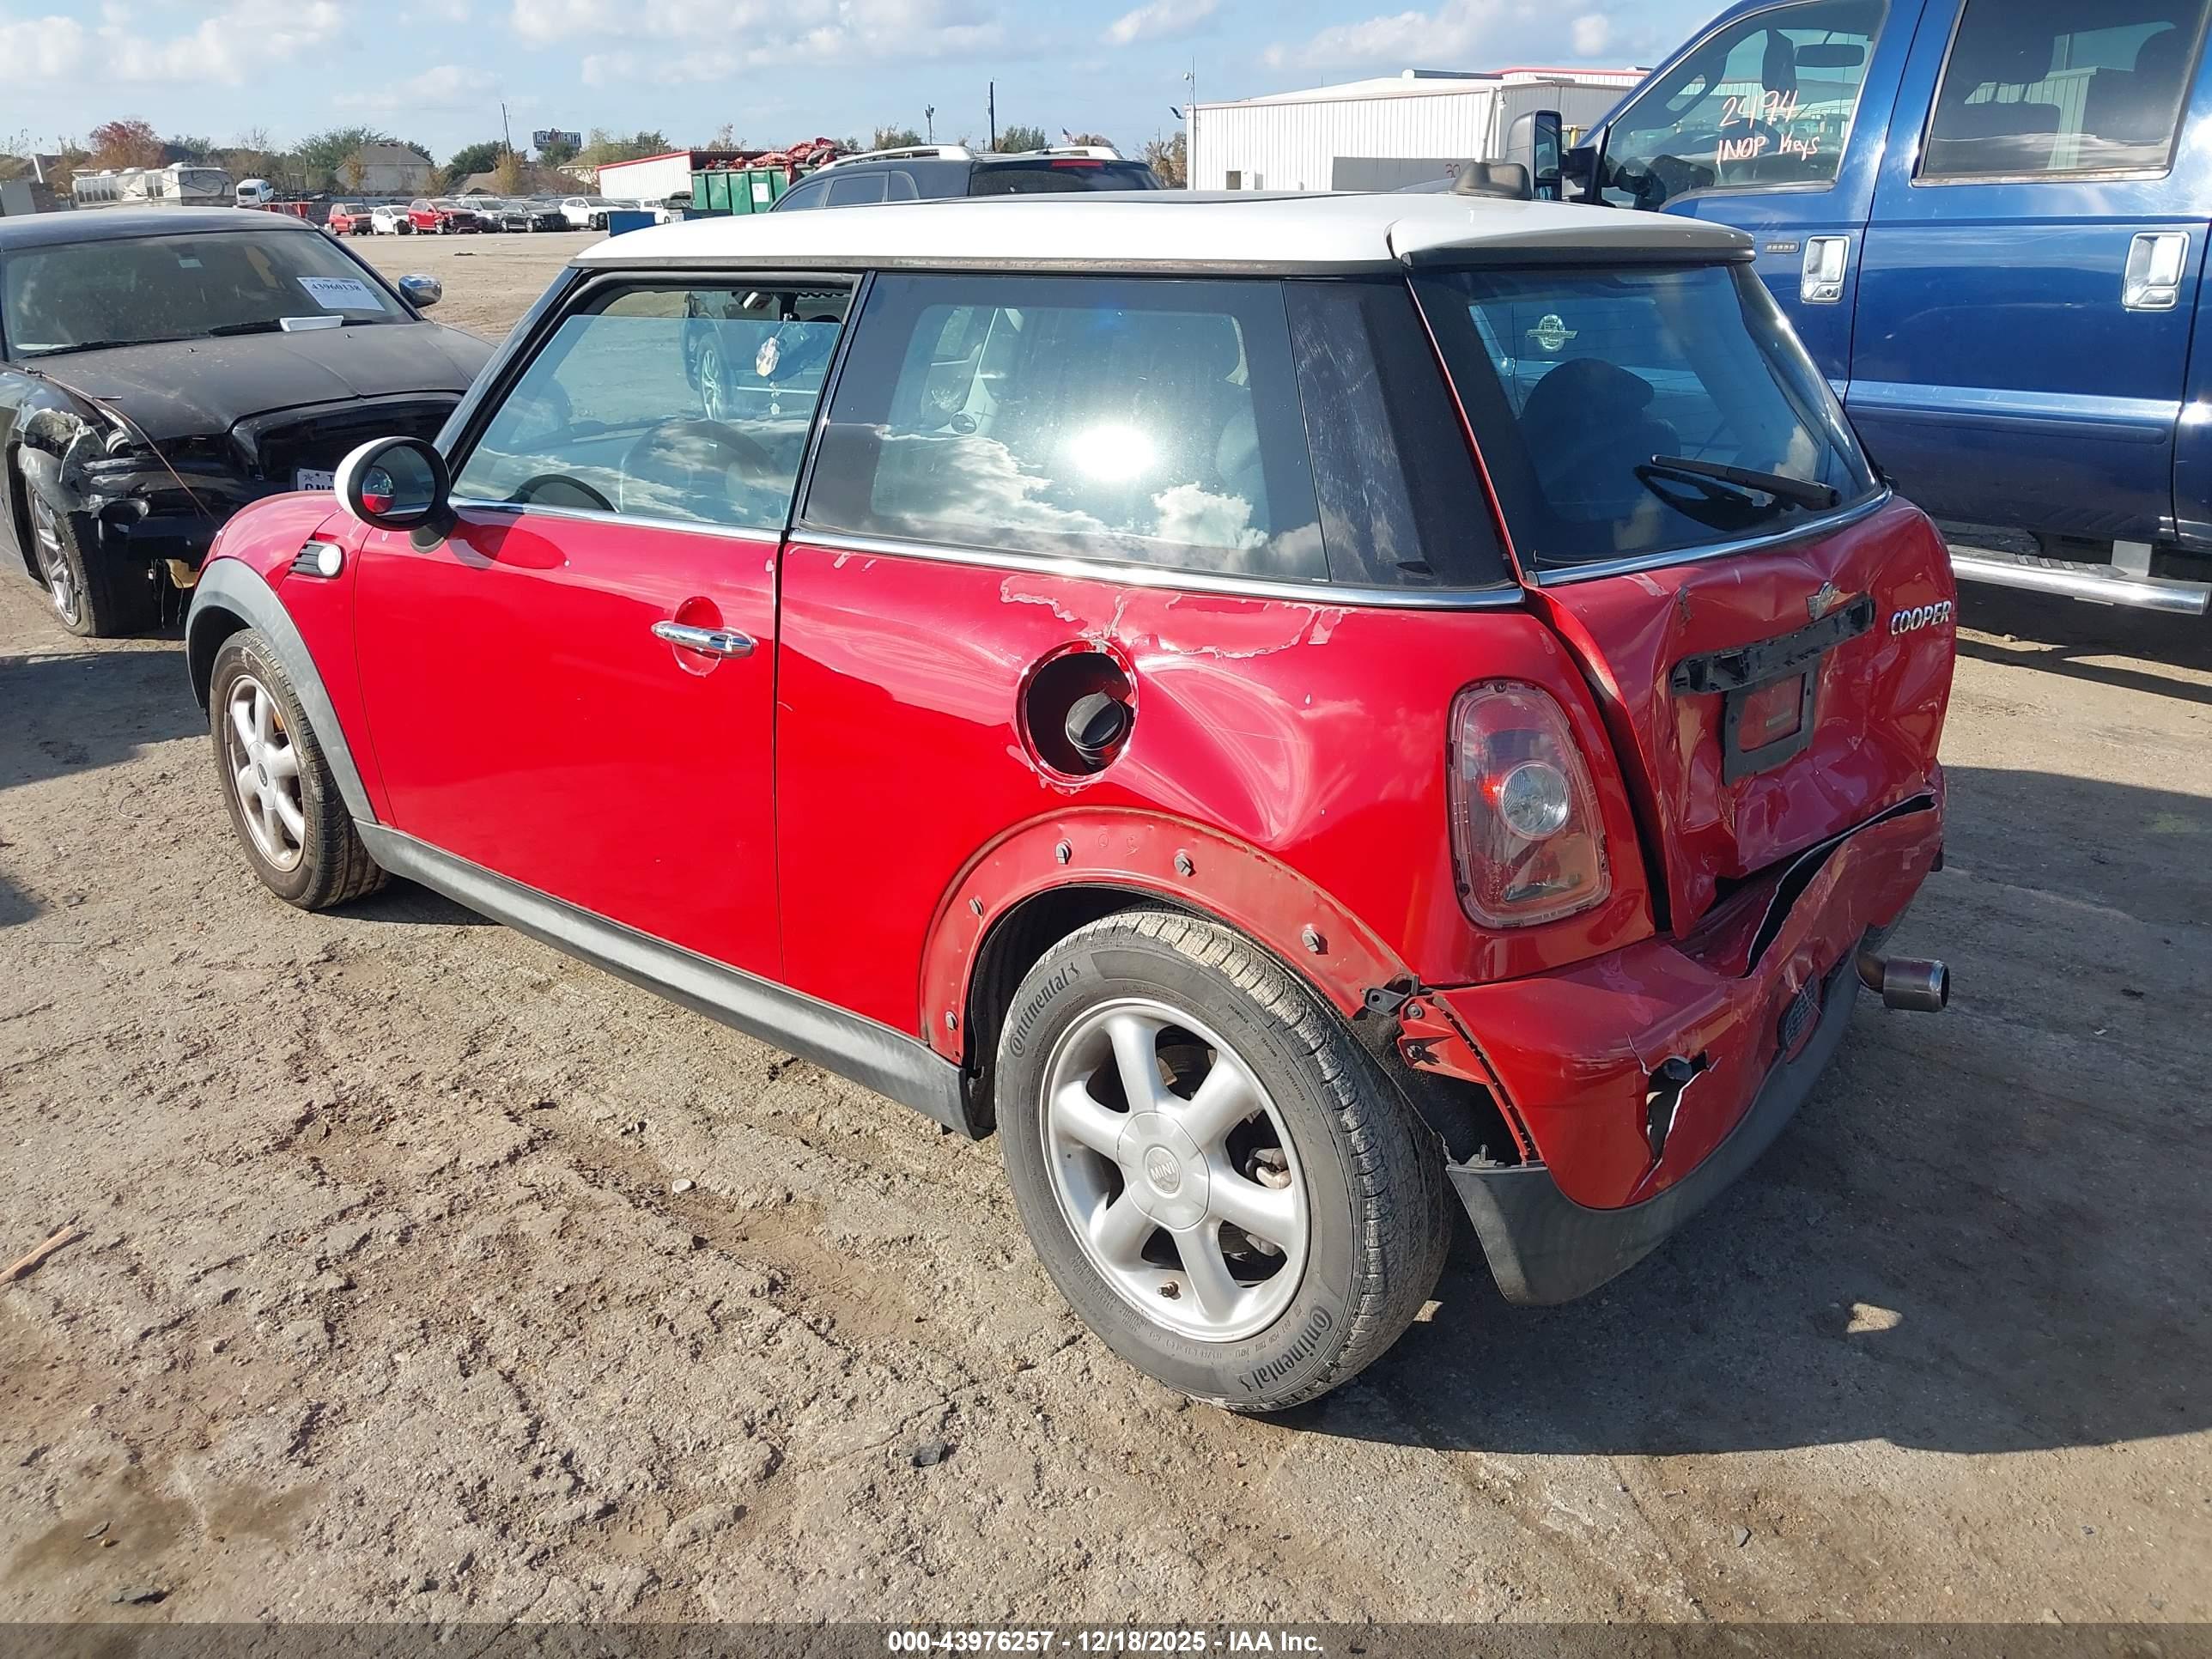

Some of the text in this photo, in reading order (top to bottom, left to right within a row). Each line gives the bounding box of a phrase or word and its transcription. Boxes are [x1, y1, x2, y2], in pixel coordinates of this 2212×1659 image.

[1716, 131, 1820, 164] INOP Keys
[1891, 600, 1953, 635] COOPER
[1009, 967, 1071, 1058] Continental
[1150, 1161, 1176, 1182] MINI
[1250, 1305, 1334, 1389] Continental
